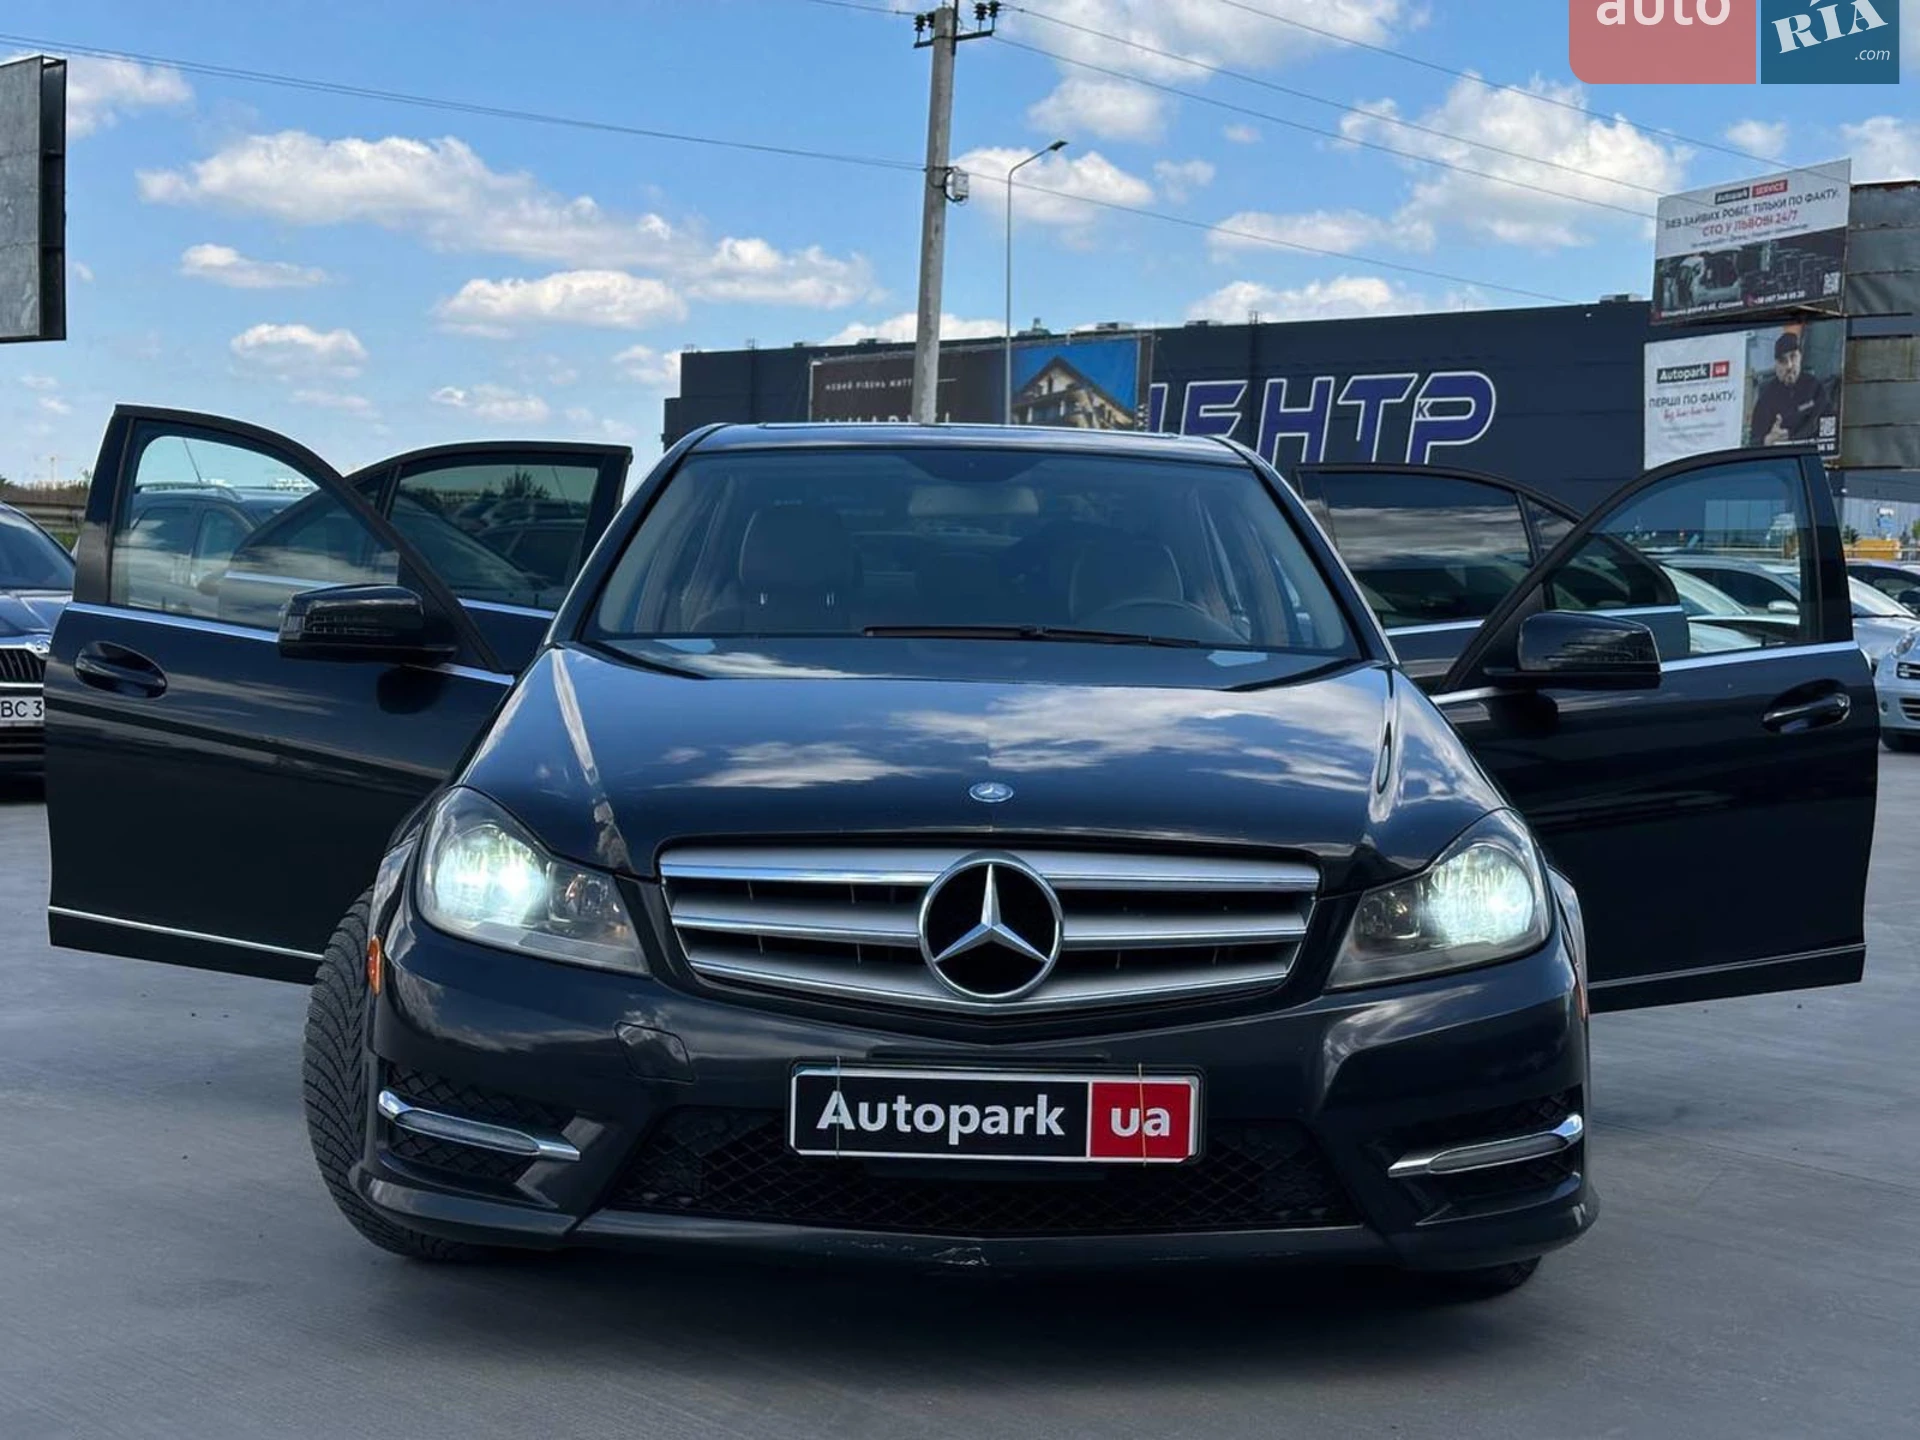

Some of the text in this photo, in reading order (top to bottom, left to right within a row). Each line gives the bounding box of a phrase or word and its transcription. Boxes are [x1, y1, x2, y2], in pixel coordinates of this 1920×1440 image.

[1752, 199, 1787, 213] ТІЛЬКИ
[1788, 195, 1803, 207] ПО
[1702, 223, 1723, 238] СТО
[1725, 222, 1732, 234] У
[1733, 215, 1774, 232] ЛЬВОВІ
[1775, 210, 1798, 225] 24/7
[1659, 365, 1708, 381] Autopark
[1648, 395, 1681, 408] ПЕРШІ
[1683, 393, 1698, 405] ПО
[1, 701, 28, 718] BC
[816, 1090, 1171, 1146] Autopark ua
